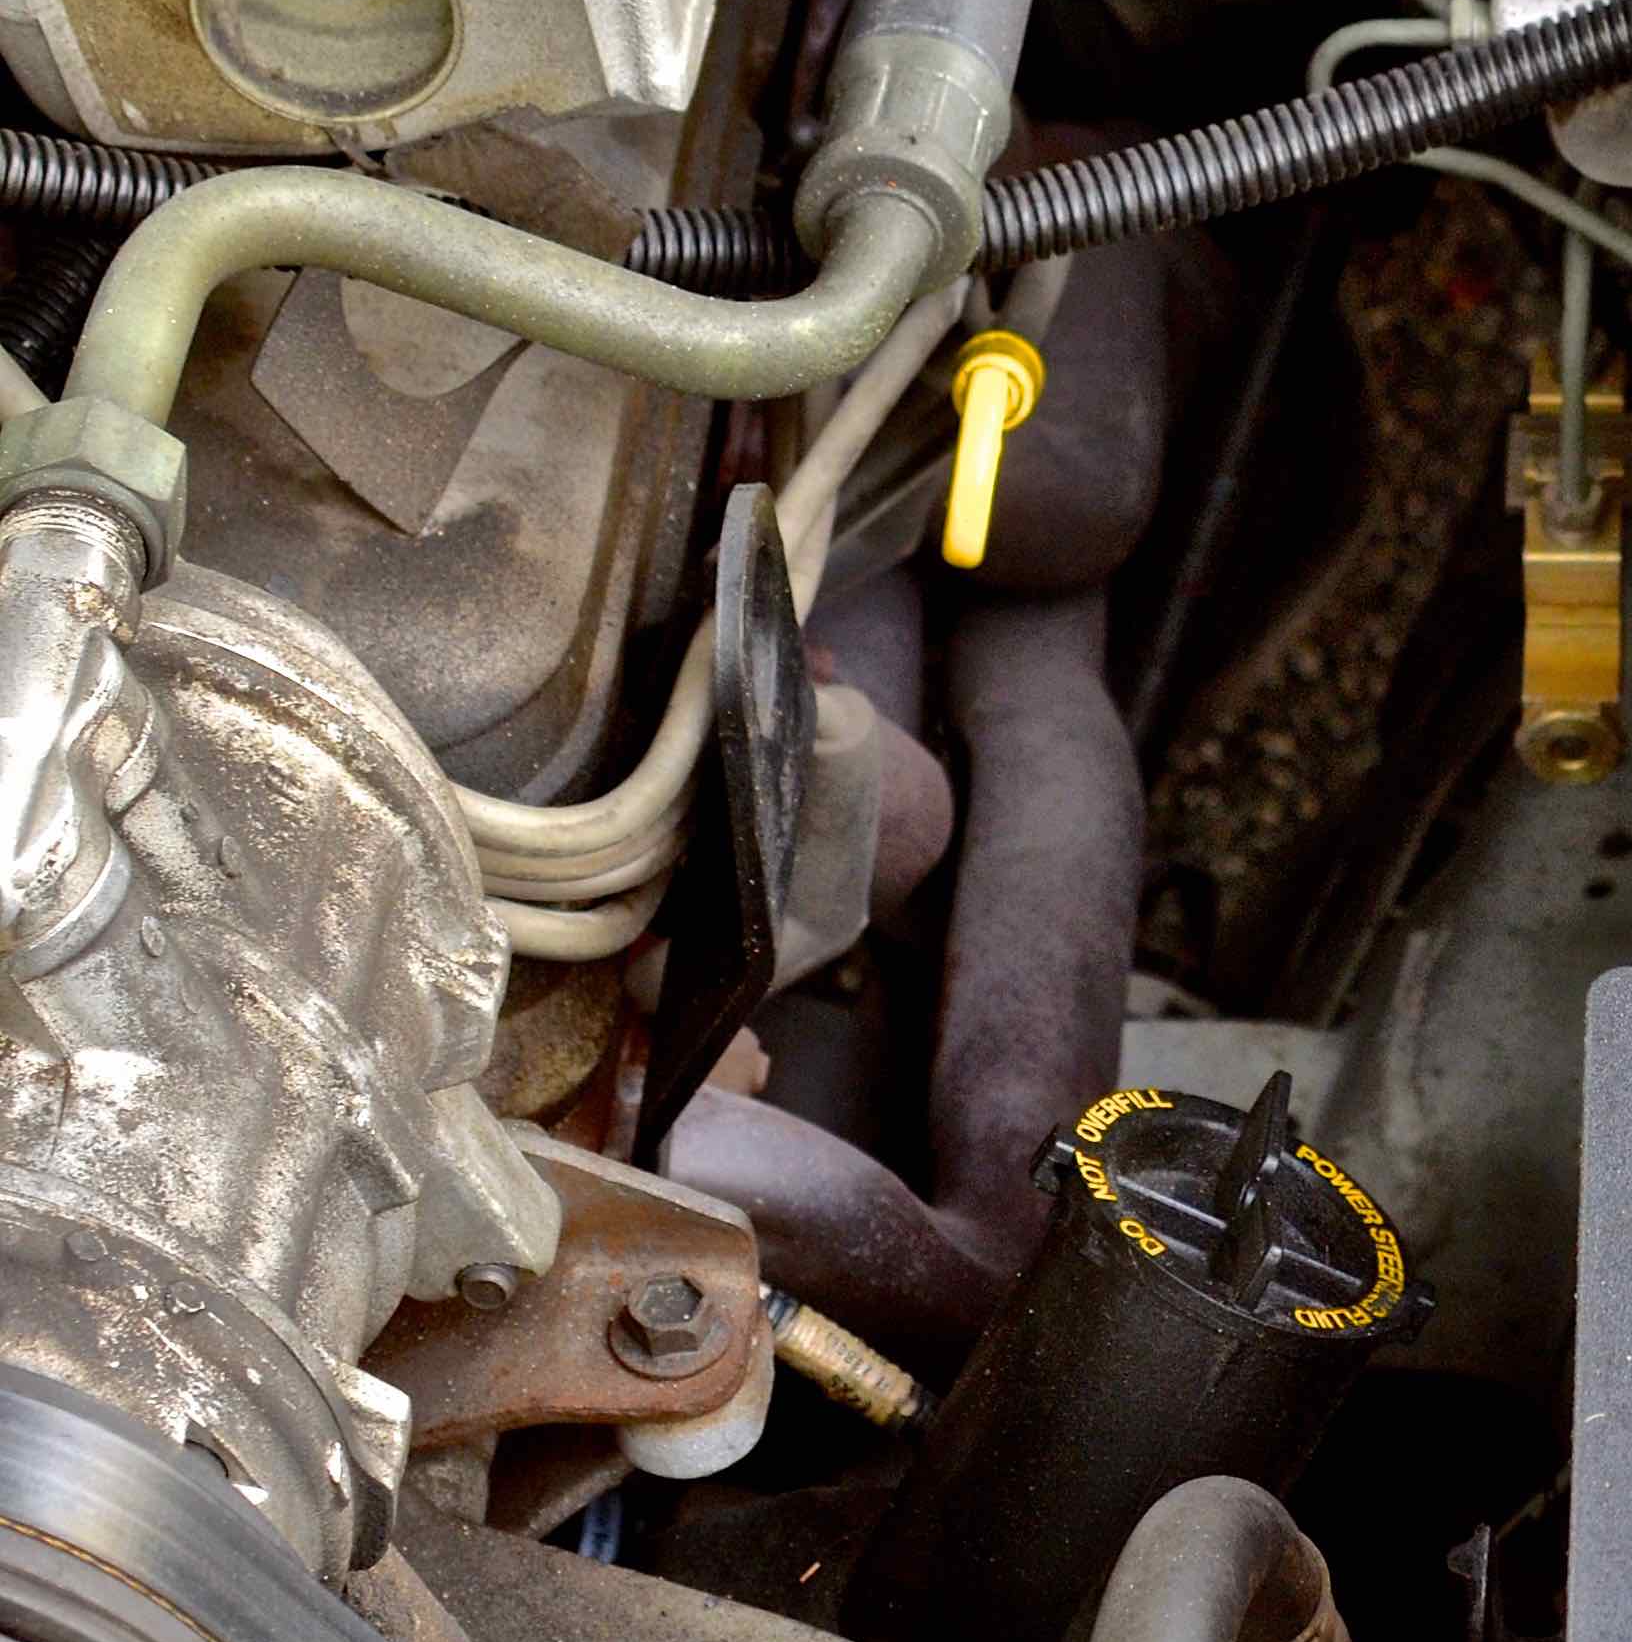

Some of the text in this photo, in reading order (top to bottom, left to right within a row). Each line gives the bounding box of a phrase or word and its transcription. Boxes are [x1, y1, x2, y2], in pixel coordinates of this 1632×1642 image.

[1074, 1088, 1176, 1257] DO NOT OVERFILL
[1295, 1143, 1385, 1226] POWER
[1294, 1305, 1374, 1330] FLUID
